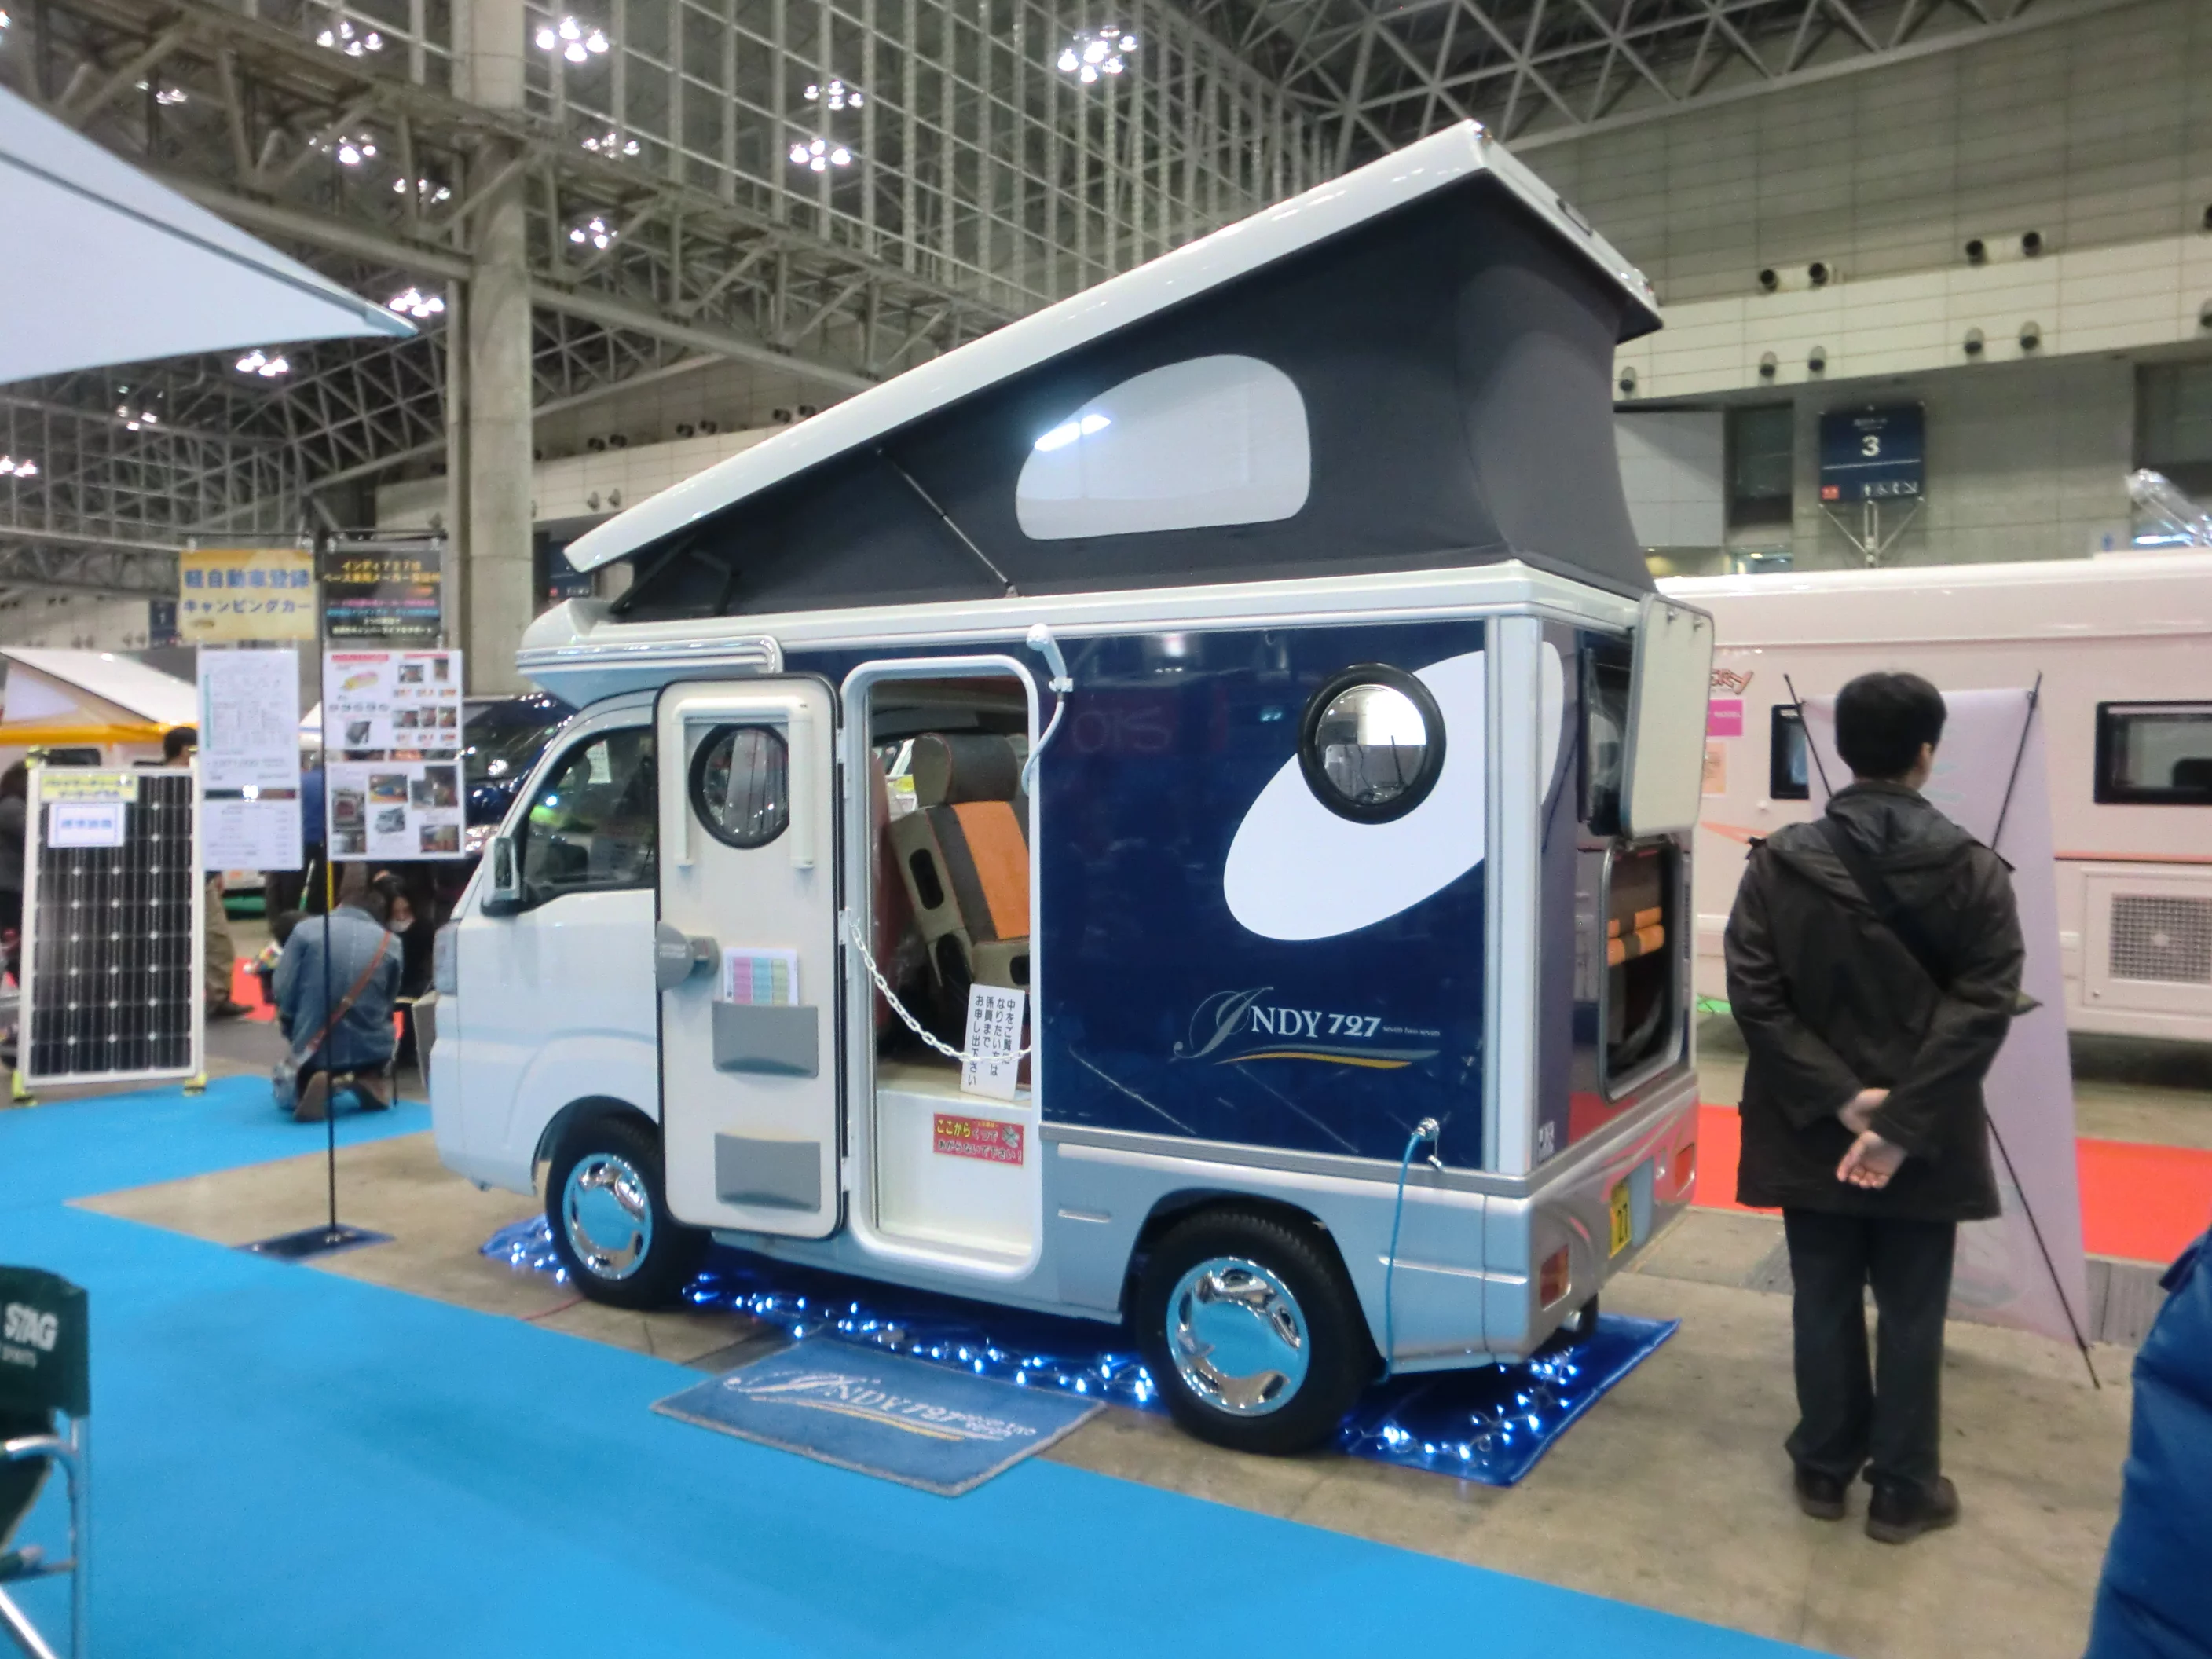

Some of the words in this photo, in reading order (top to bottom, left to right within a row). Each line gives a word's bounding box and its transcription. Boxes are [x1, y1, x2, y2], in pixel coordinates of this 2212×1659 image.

[1862, 435, 1881, 456] 3
[983, 995, 994, 1048] 係員まで
[1328, 1014, 1382, 1037] 727
[5, 1302, 59, 1351] STAG
